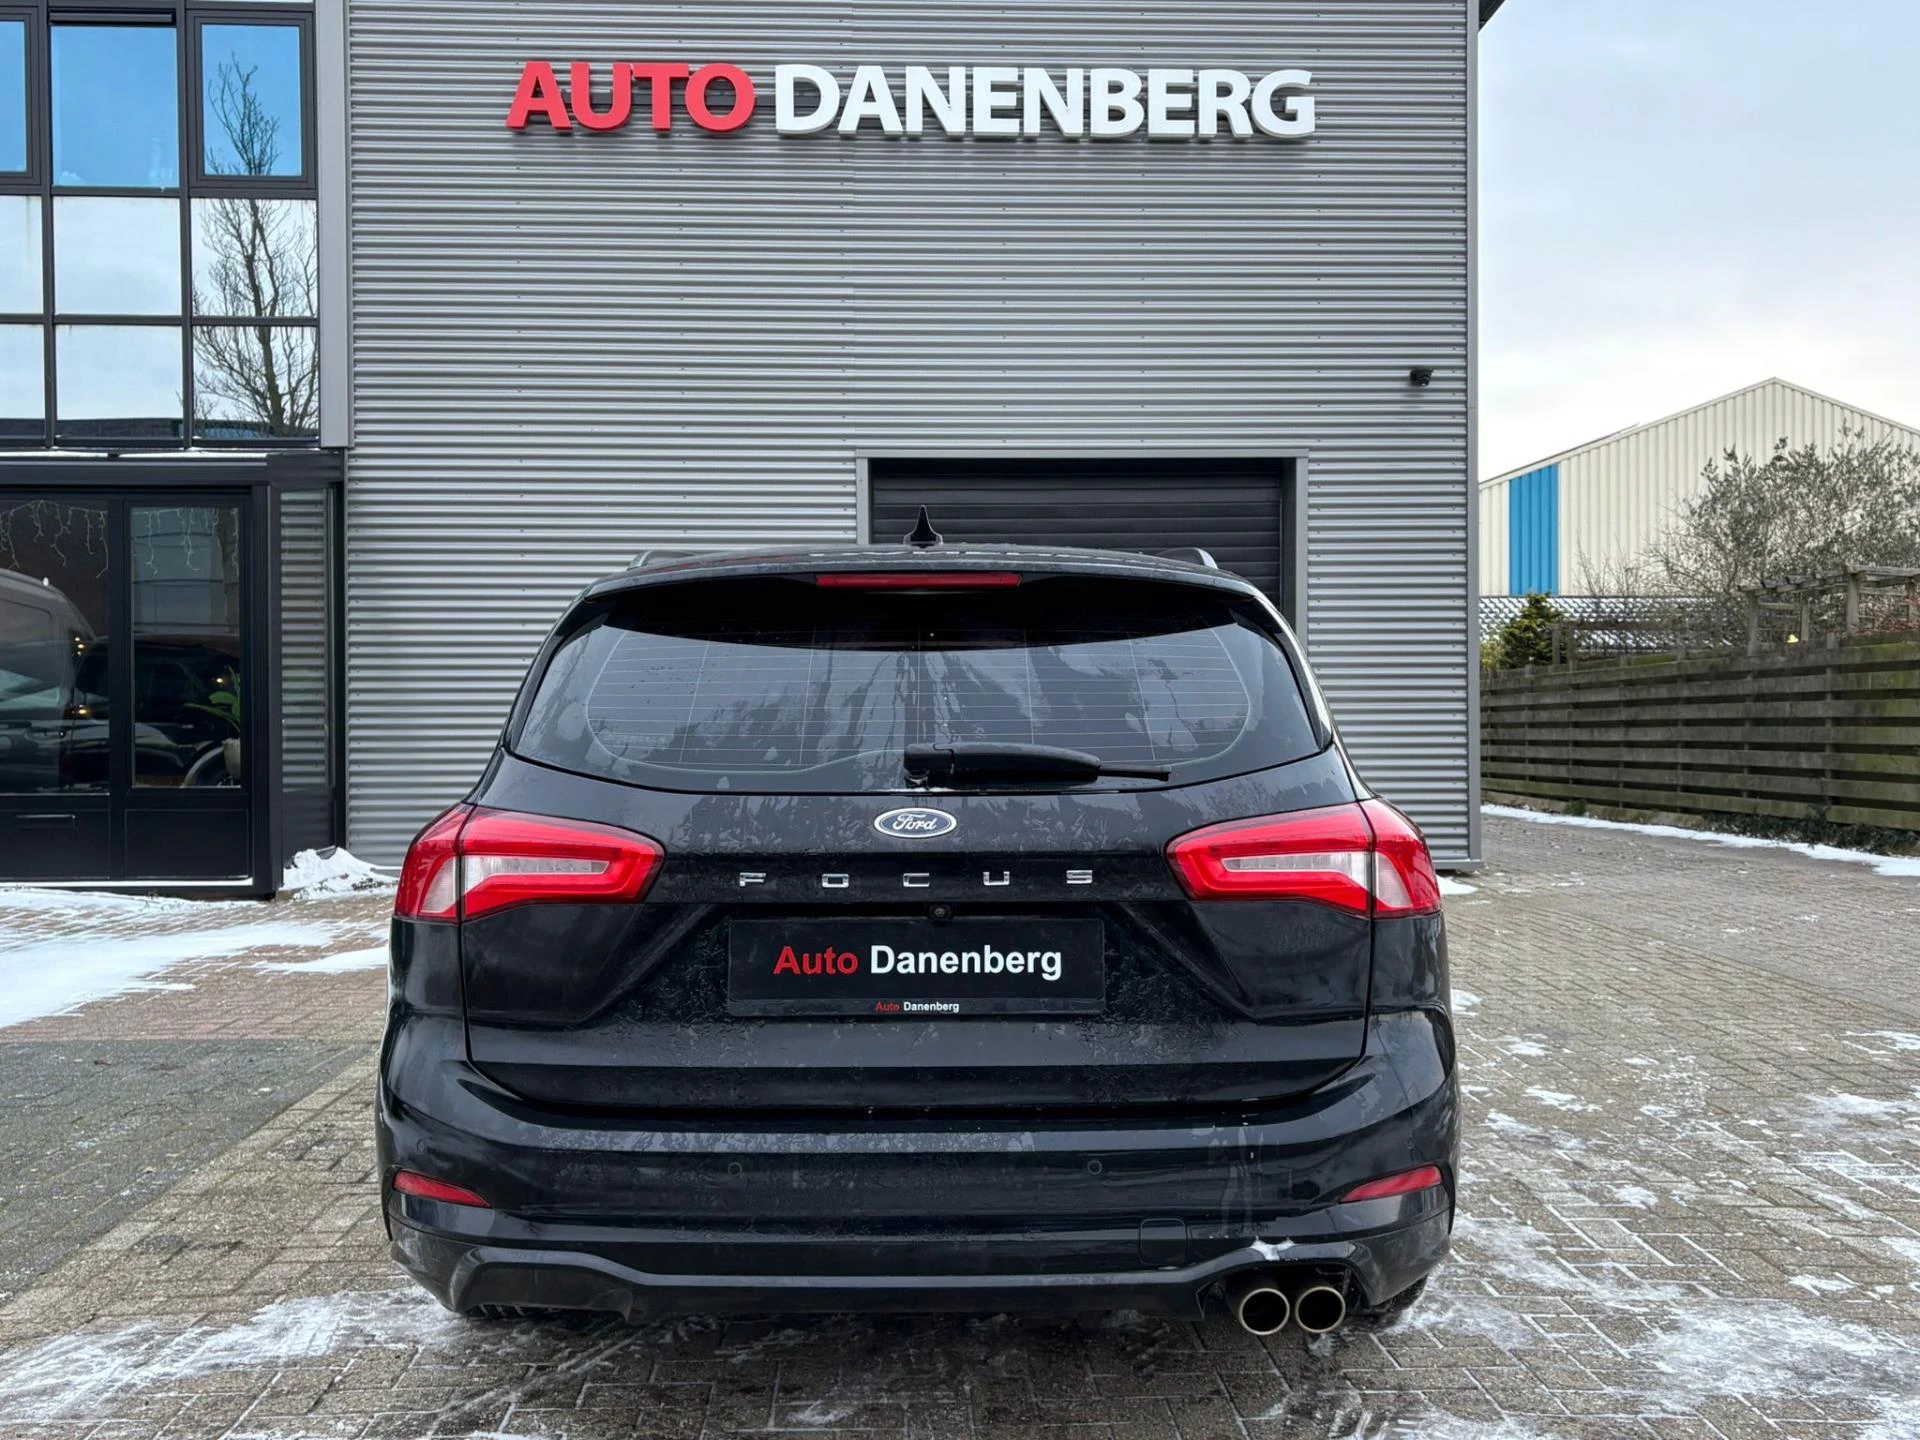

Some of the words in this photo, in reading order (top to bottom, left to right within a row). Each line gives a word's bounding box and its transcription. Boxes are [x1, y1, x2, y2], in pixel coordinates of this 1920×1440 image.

[506, 61, 756, 132] AUTO
[774, 64, 1317, 138] DANENBERG
[892, 813, 938, 832] Ford
[739, 869, 1093, 888] FOCUS
[773, 945, 858, 975] Auto
[870, 944, 1062, 981] Danenberg
[875, 1001, 900, 1012] Auto
[903, 1001, 960, 1013] Danenberg
